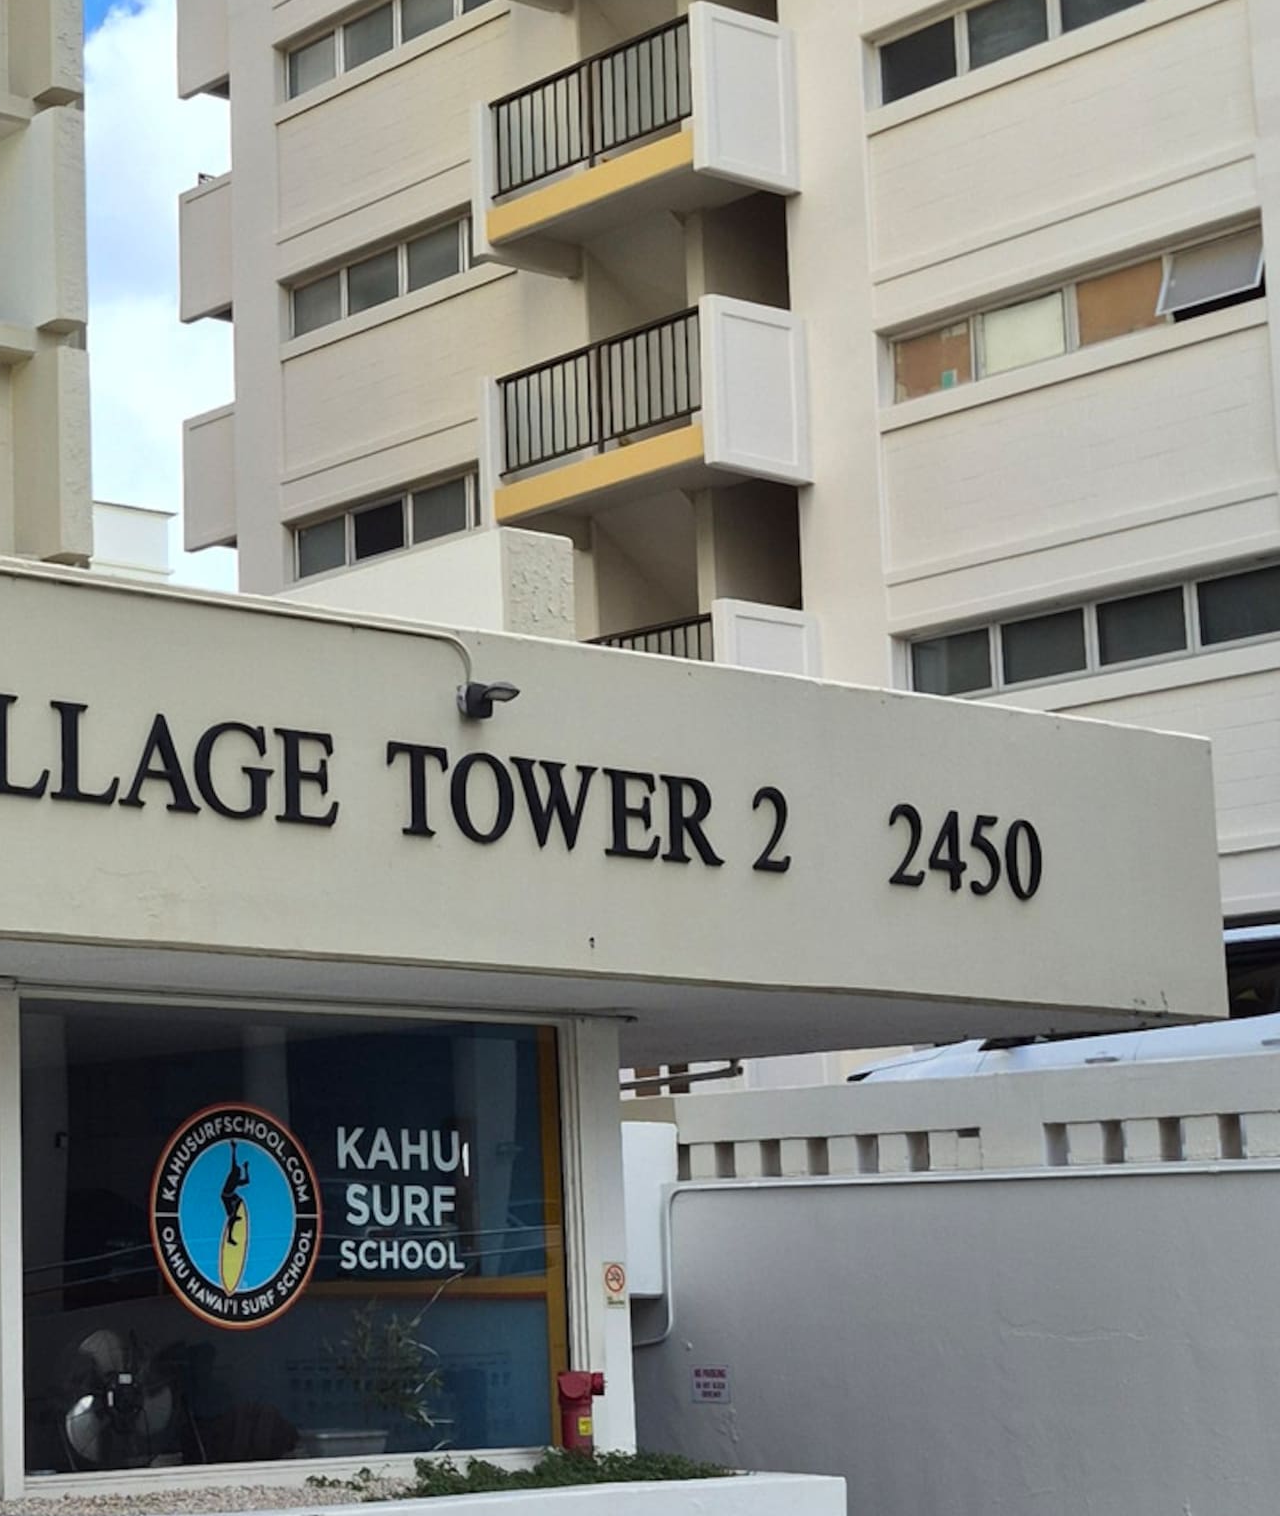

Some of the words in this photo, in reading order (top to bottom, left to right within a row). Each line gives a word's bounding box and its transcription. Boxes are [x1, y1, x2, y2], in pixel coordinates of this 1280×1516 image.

[386, 740, 726, 867] TOWER
[751, 785, 792, 873] 2
[888, 802, 1043, 901] 2450
[161, 1115, 310, 1203] KAHUSURFSCHOOL.COM
[336, 1125, 461, 1173] KAHU
[346, 1184, 456, 1226] SURF
[161, 1227, 188, 1278] OAHU
[241, 1293, 275, 1316] SURF
[279, 1229, 312, 1295] SCHOOL
[340, 1240, 465, 1270] SCHOOL
